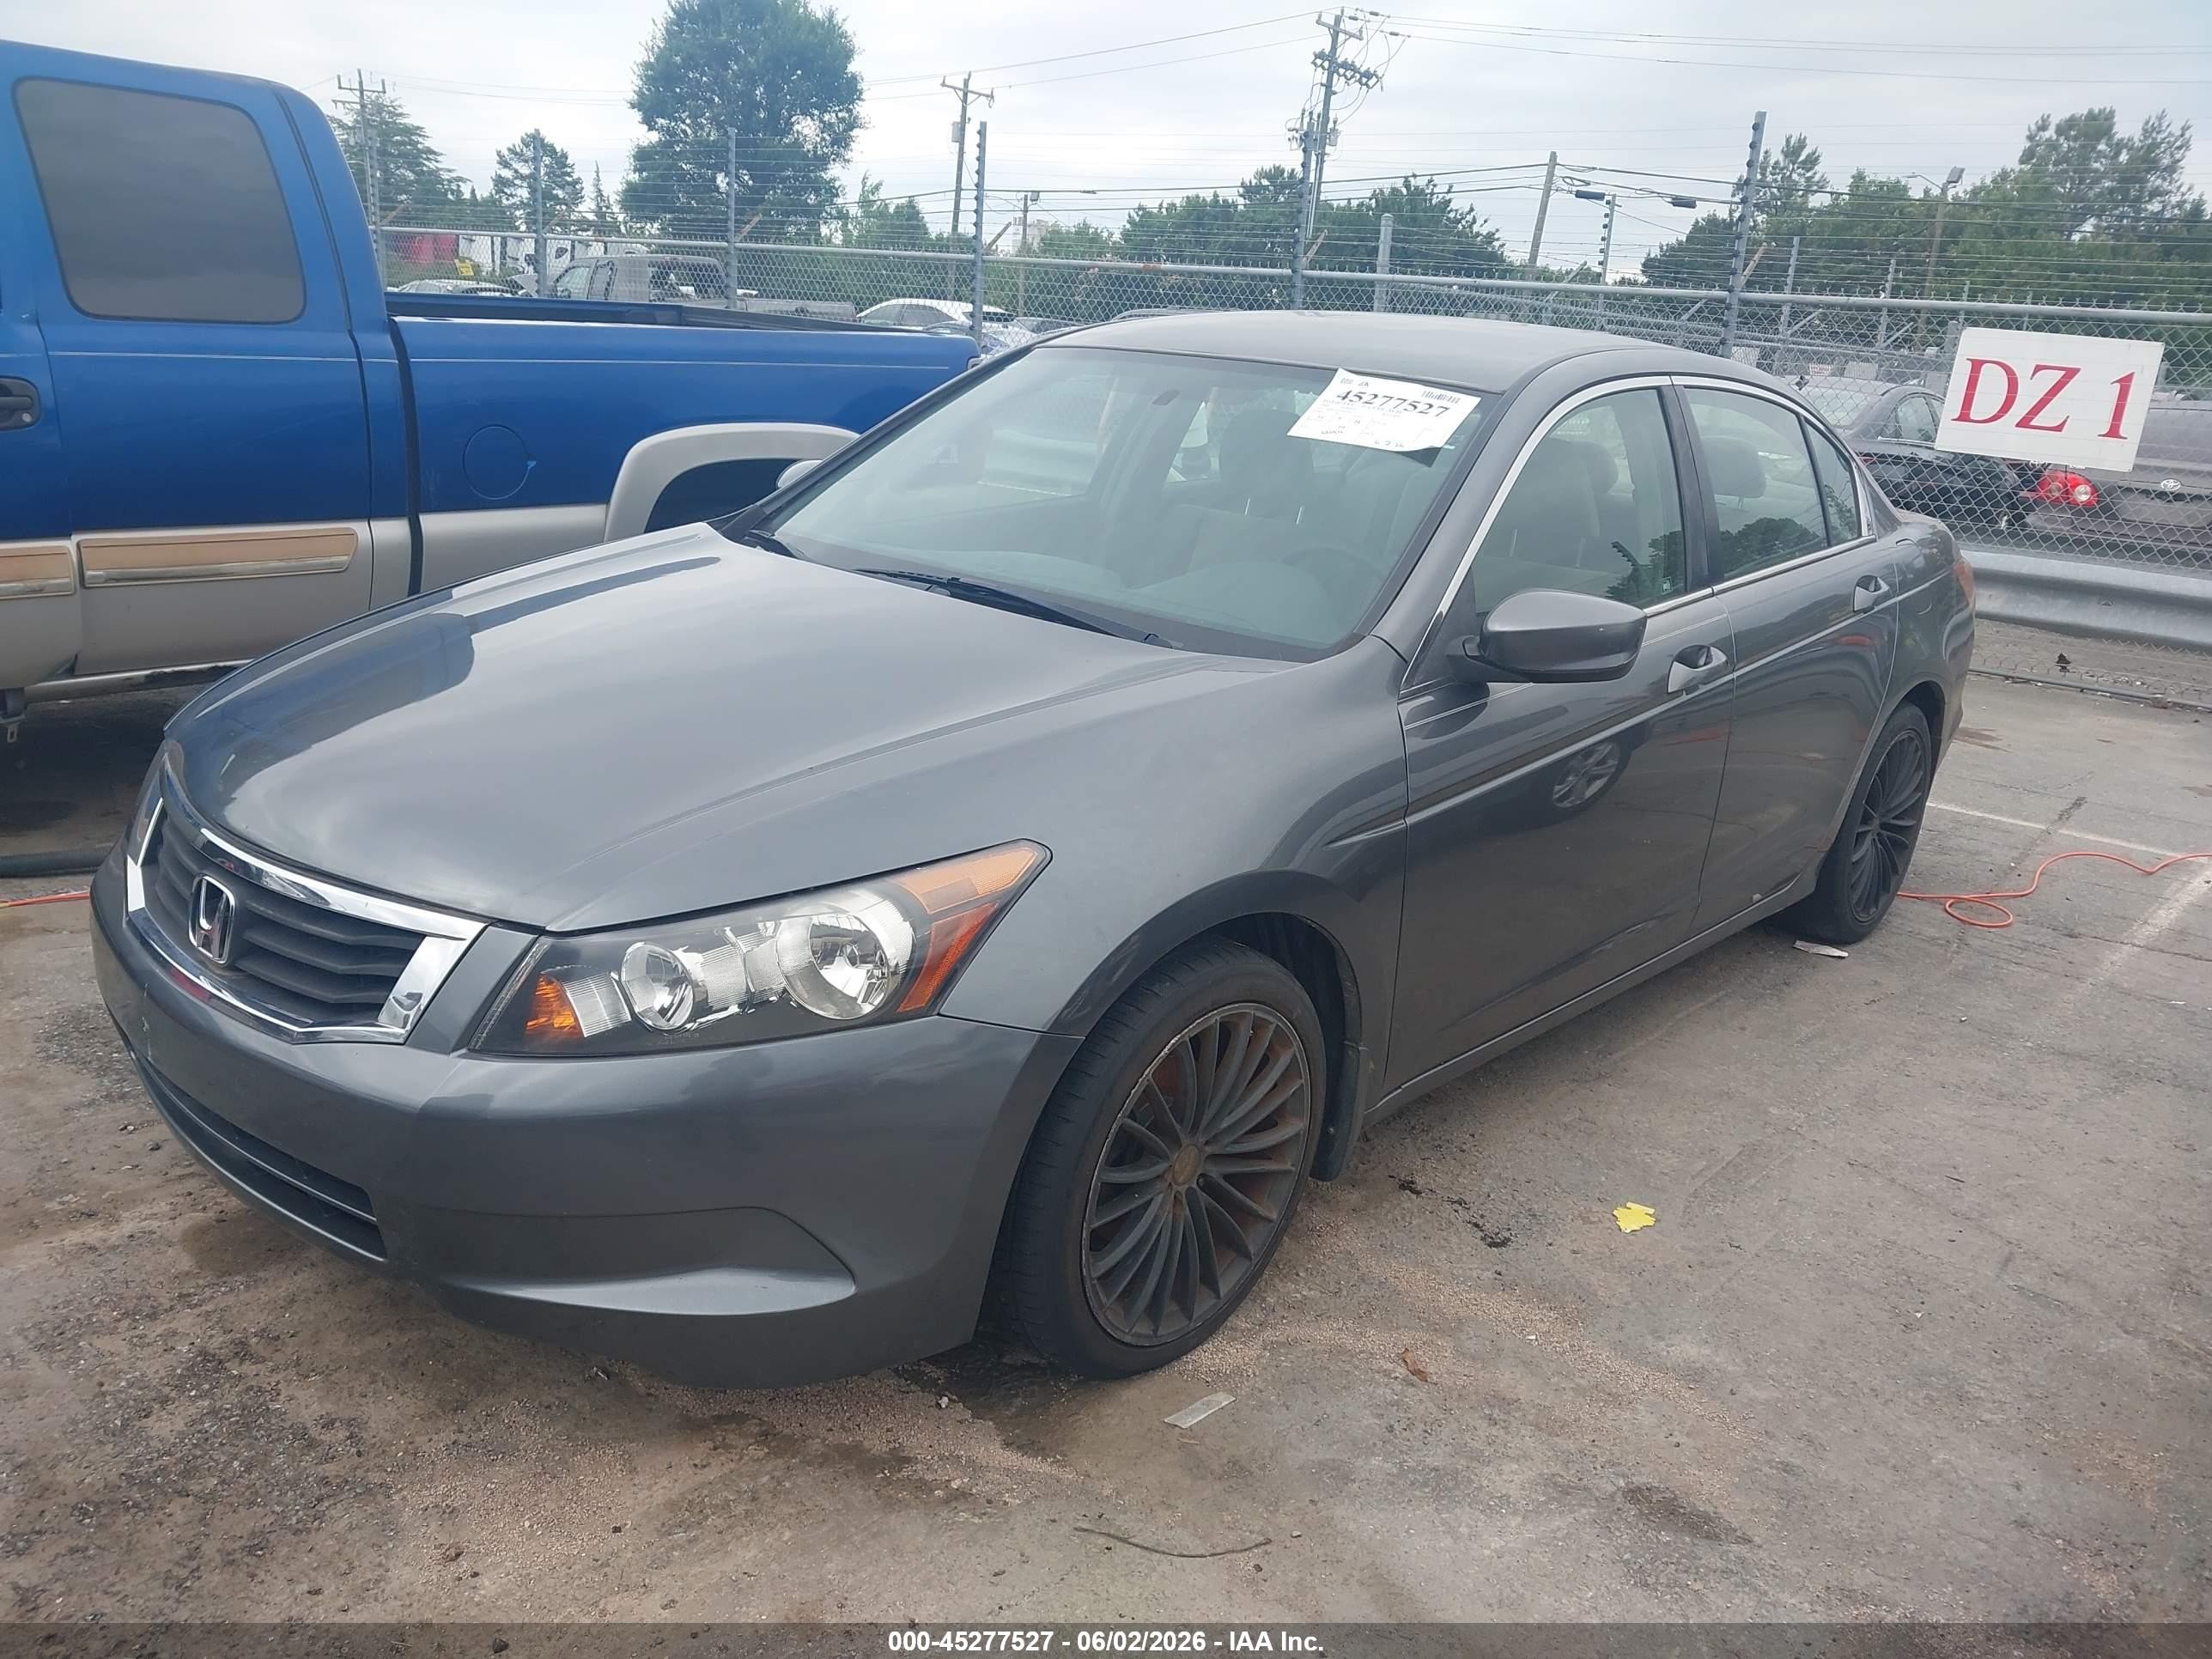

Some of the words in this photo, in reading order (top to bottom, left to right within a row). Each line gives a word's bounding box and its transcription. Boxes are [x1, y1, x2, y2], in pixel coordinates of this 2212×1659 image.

[1336, 389, 1451, 417] 45277527
[1950, 357, 2082, 433] DZ
[2097, 371, 2136, 441] 1
